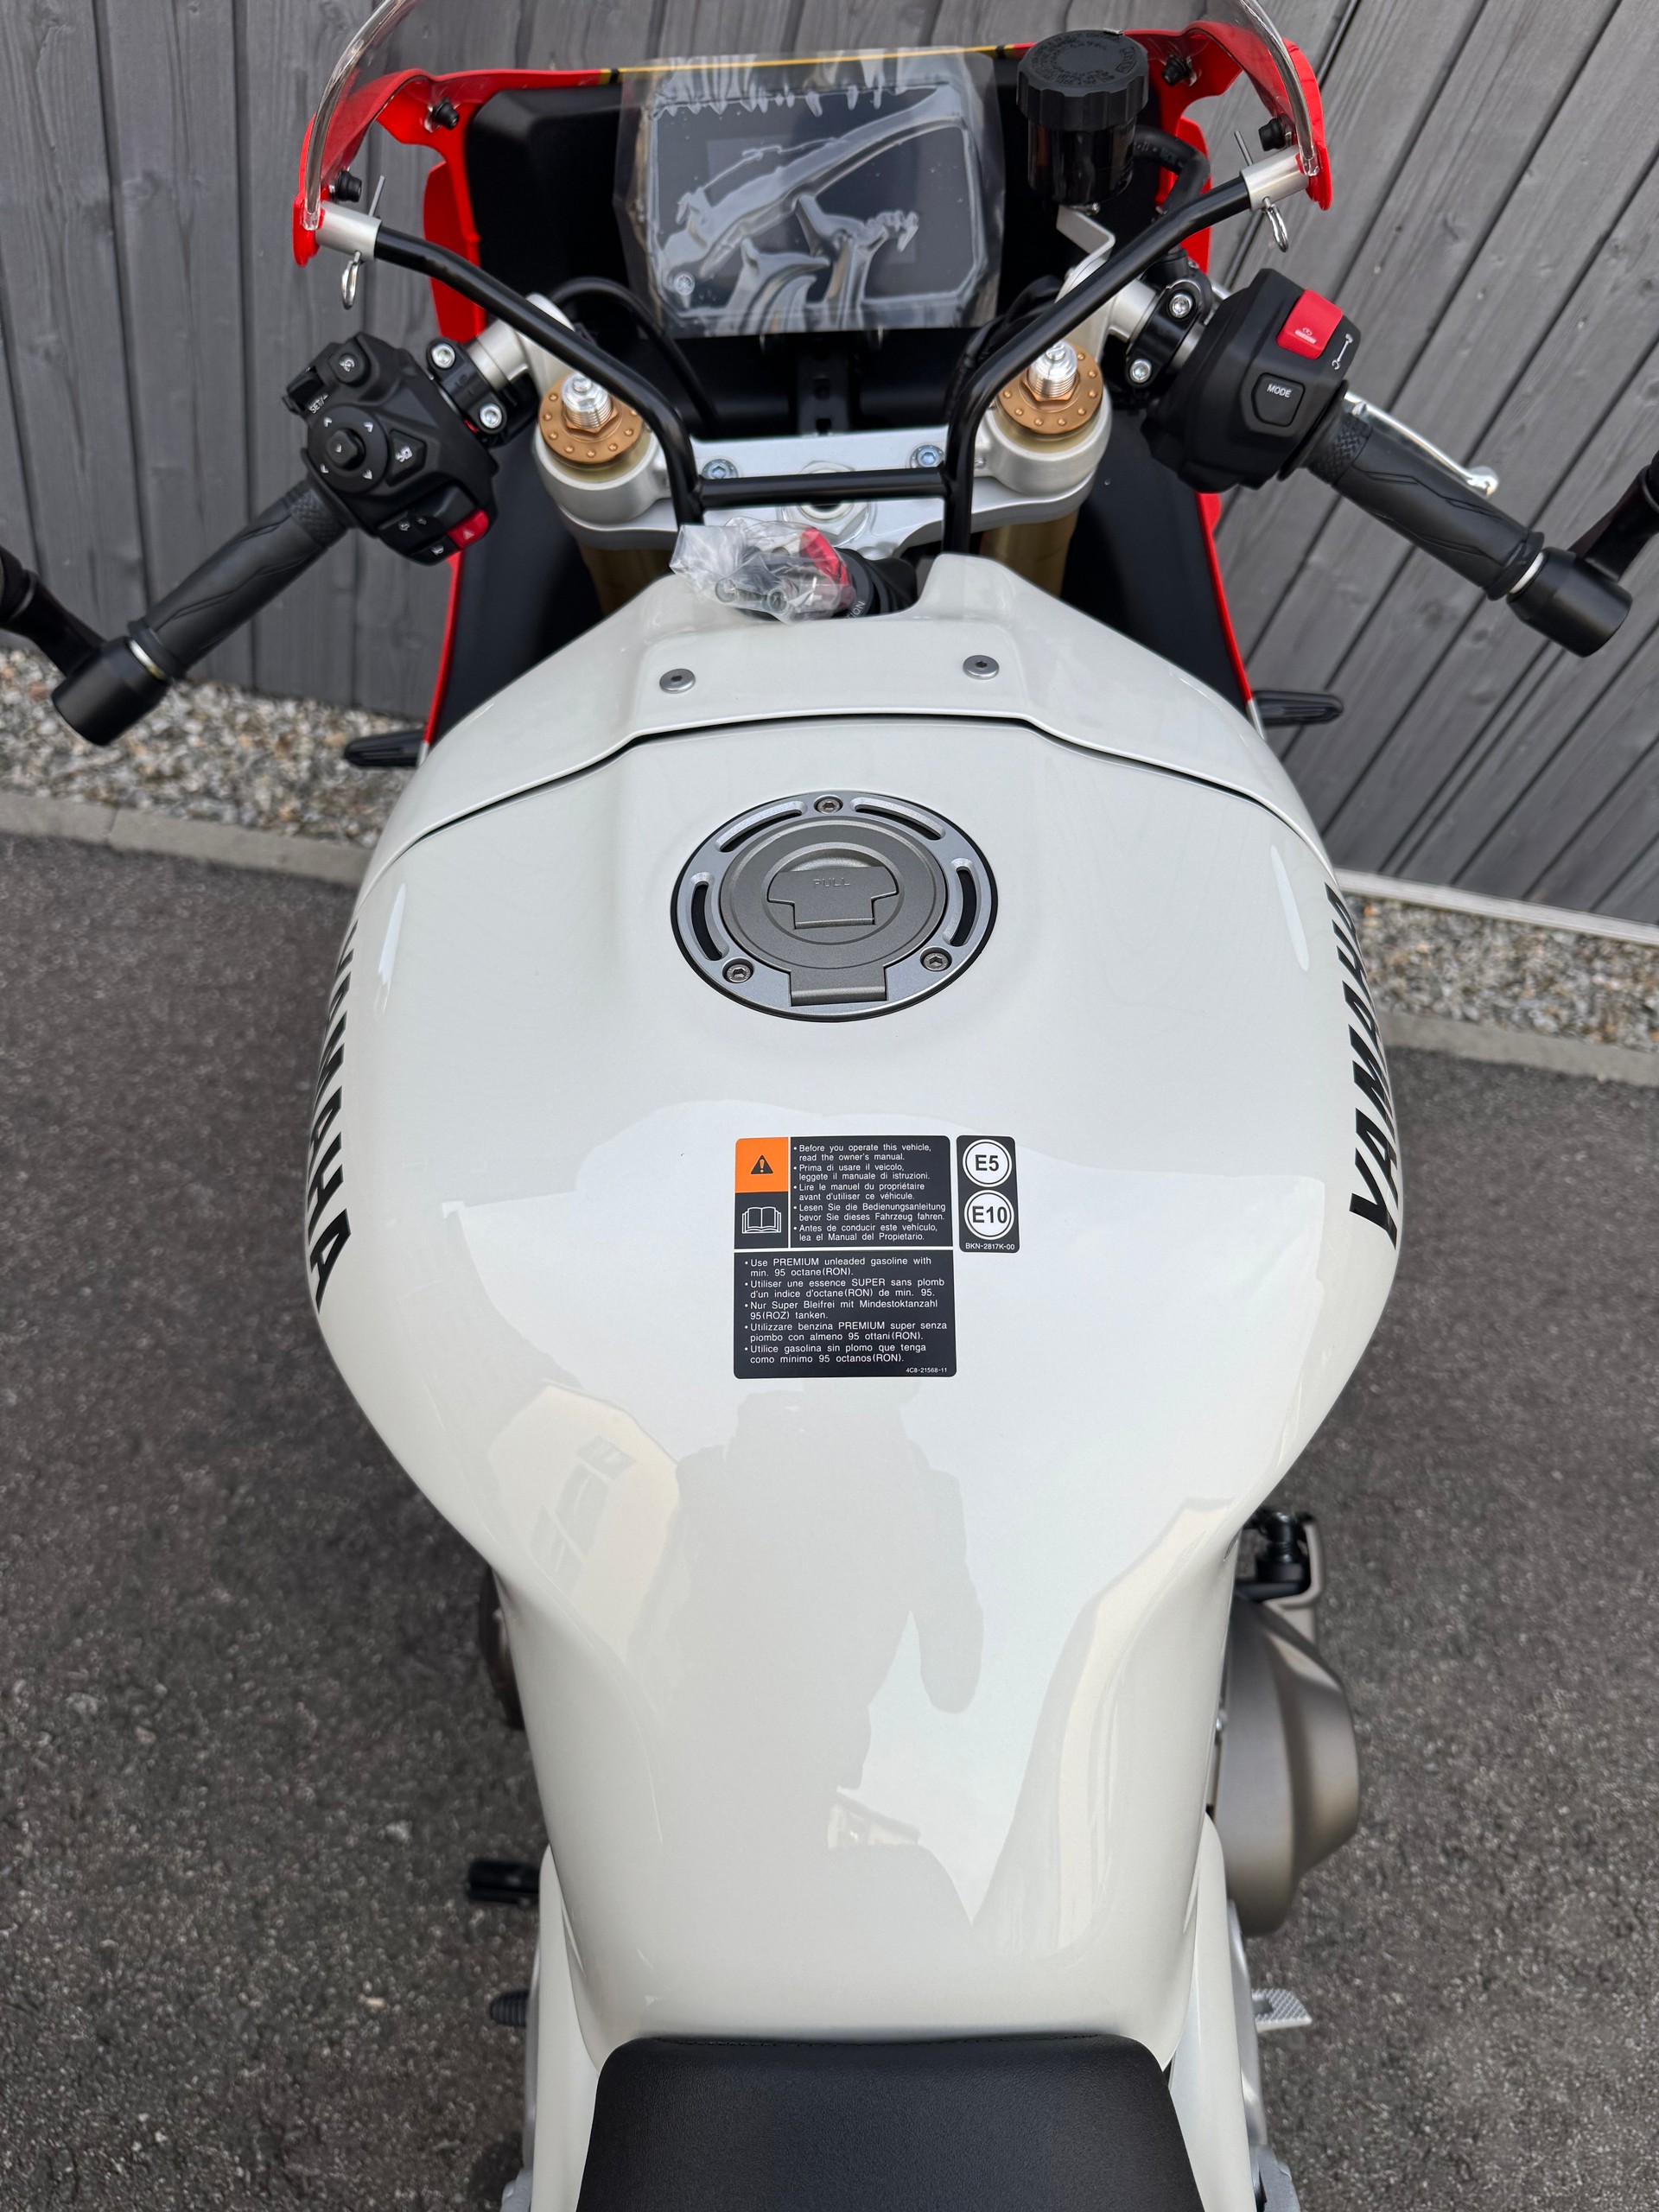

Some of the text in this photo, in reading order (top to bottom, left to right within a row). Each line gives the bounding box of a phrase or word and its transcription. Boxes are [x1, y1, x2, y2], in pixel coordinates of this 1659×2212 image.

[1267, 384, 1293, 397] MODE
[812, 877, 851, 888] PULL
[830, 1145, 843, 1154] you
[849, 1144, 879, 1153] operate
[901, 1143, 931, 1152] vehicle,
[874, 1163, 904, 1172] veicolo,
[975, 1154, 1000, 1172] E5
[799, 1173, 828, 1182] leggete
[879, 1182, 925, 1192] propriétaire
[828, 1203, 841, 1211] Sie
[862, 1203, 945, 1212] Bedienungsanleitung
[875, 1212, 912, 1222] Fahrzeug
[972, 1205, 1008, 1224] E10
[826, 1224, 836, 1232] de
[861, 1232, 874, 1241] del
[879, 1232, 925, 1242] Propietario.
[965, 1242, 1015, 1250] BKN-2817K-00
[773, 1257, 819, 1266] PREMIUM
[870, 1256, 908, 1267] gasoline
[913, 1256, 931, 1265] with
[751, 1268, 769, 1277] min.
[751, 1280, 782, 1288] Utiliser
[851, 1278, 885, 1287] SUPER
[918, 1278, 944, 1287] plomb
[750, 1290, 769, 1299] d'un
[879, 1288, 890, 1297] de
[772, 1300, 798, 1311] Super
[841, 1300, 854, 1308] mit
[860, 1300, 938, 1308] Mindestoktanzahl
[795, 1311, 828, 1319] tanken.
[751, 1323, 792, 1332] Utilizzare
[798, 1322, 833, 1331] benzina
[838, 1321, 885, 1330] PREMIUM
[750, 1333, 783, 1344] piombo
[810, 1332, 842, 1341] almeno
[751, 1344, 779, 1353] Utilice
[784, 1344, 822, 1355] gasolina
[846, 1344, 873, 1353] plomo
[879, 1344, 895, 1353] que
[900, 1344, 926, 1353] tenga
[818, 1354, 830, 1363] 95
